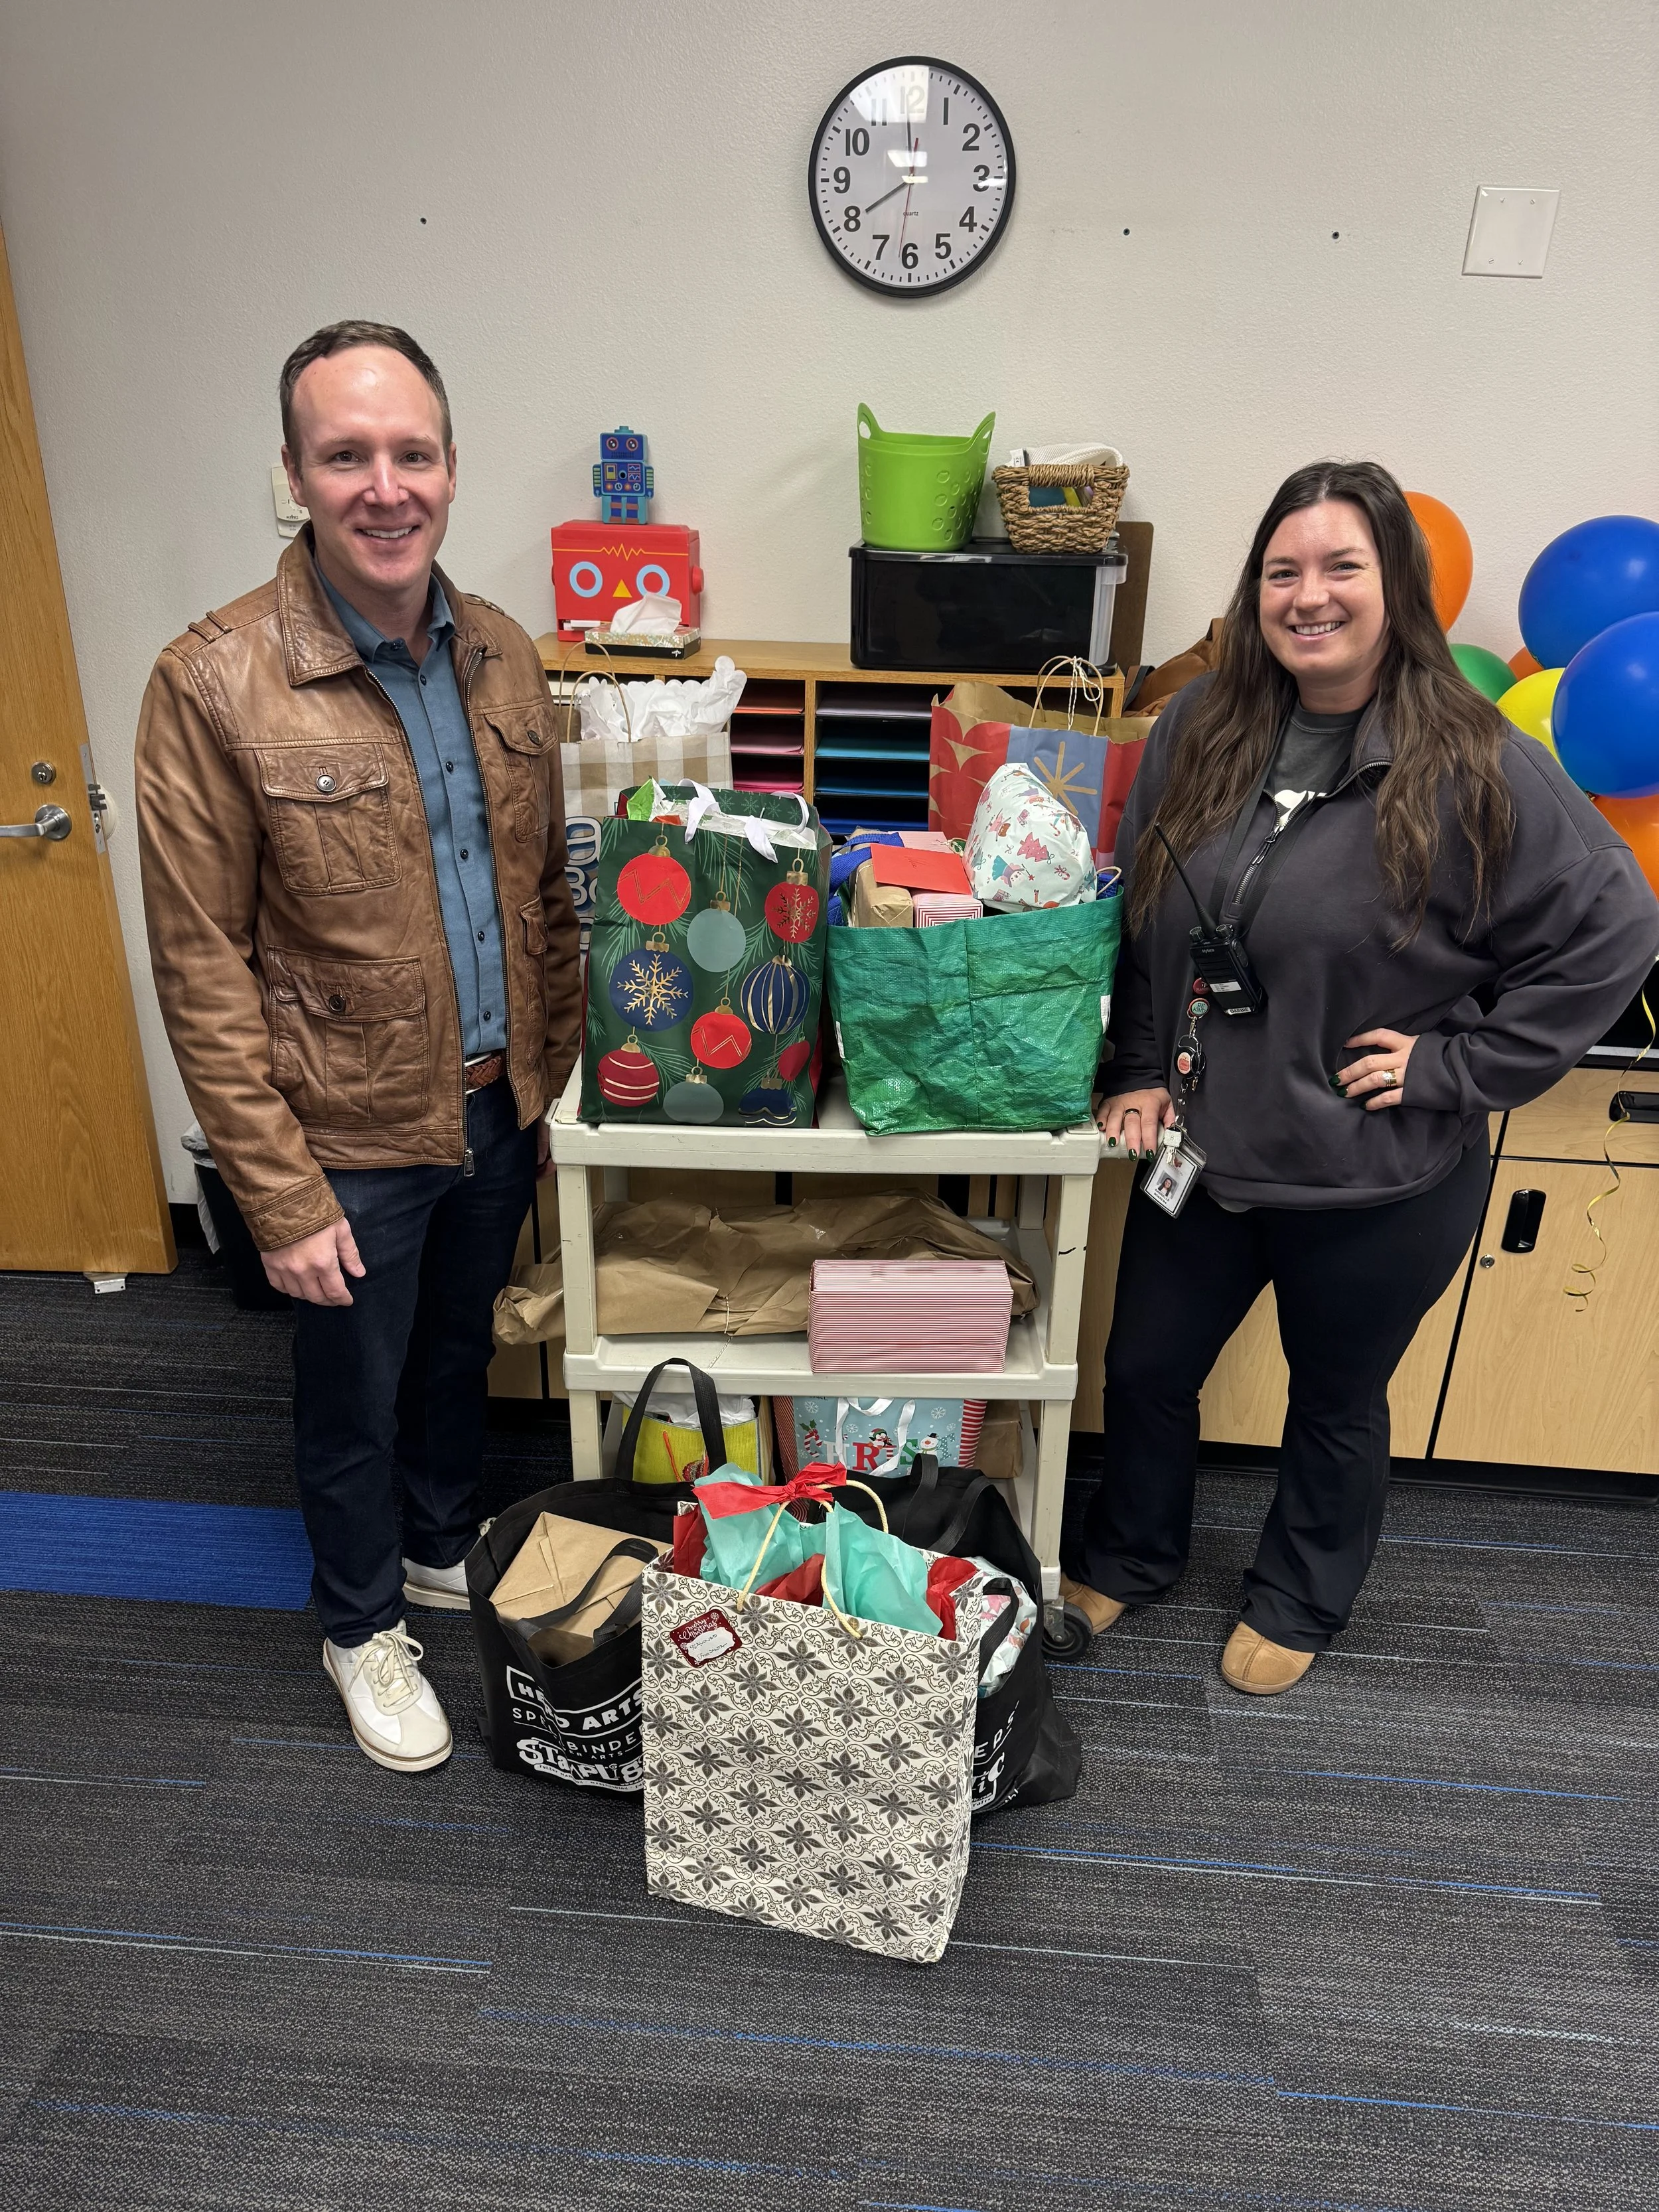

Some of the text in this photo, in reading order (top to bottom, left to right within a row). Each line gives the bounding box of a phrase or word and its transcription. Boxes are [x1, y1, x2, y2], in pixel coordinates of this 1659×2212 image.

[871, 98, 887, 126] 11
[900, 85, 924, 114] 12
[943, 97, 949, 125] 1
[845, 127, 870, 156] 10
[962, 123, 980, 151] 2
[833, 167, 851, 193] 9
[973, 165, 990, 192] 3
[843, 206, 861, 232] 8
[959, 206, 977, 232] 4
[873, 234, 890, 260] 7
[901, 243, 918, 269] 6
[935, 233, 952, 259] 5
[591, 1751, 623, 1759] ARTS
